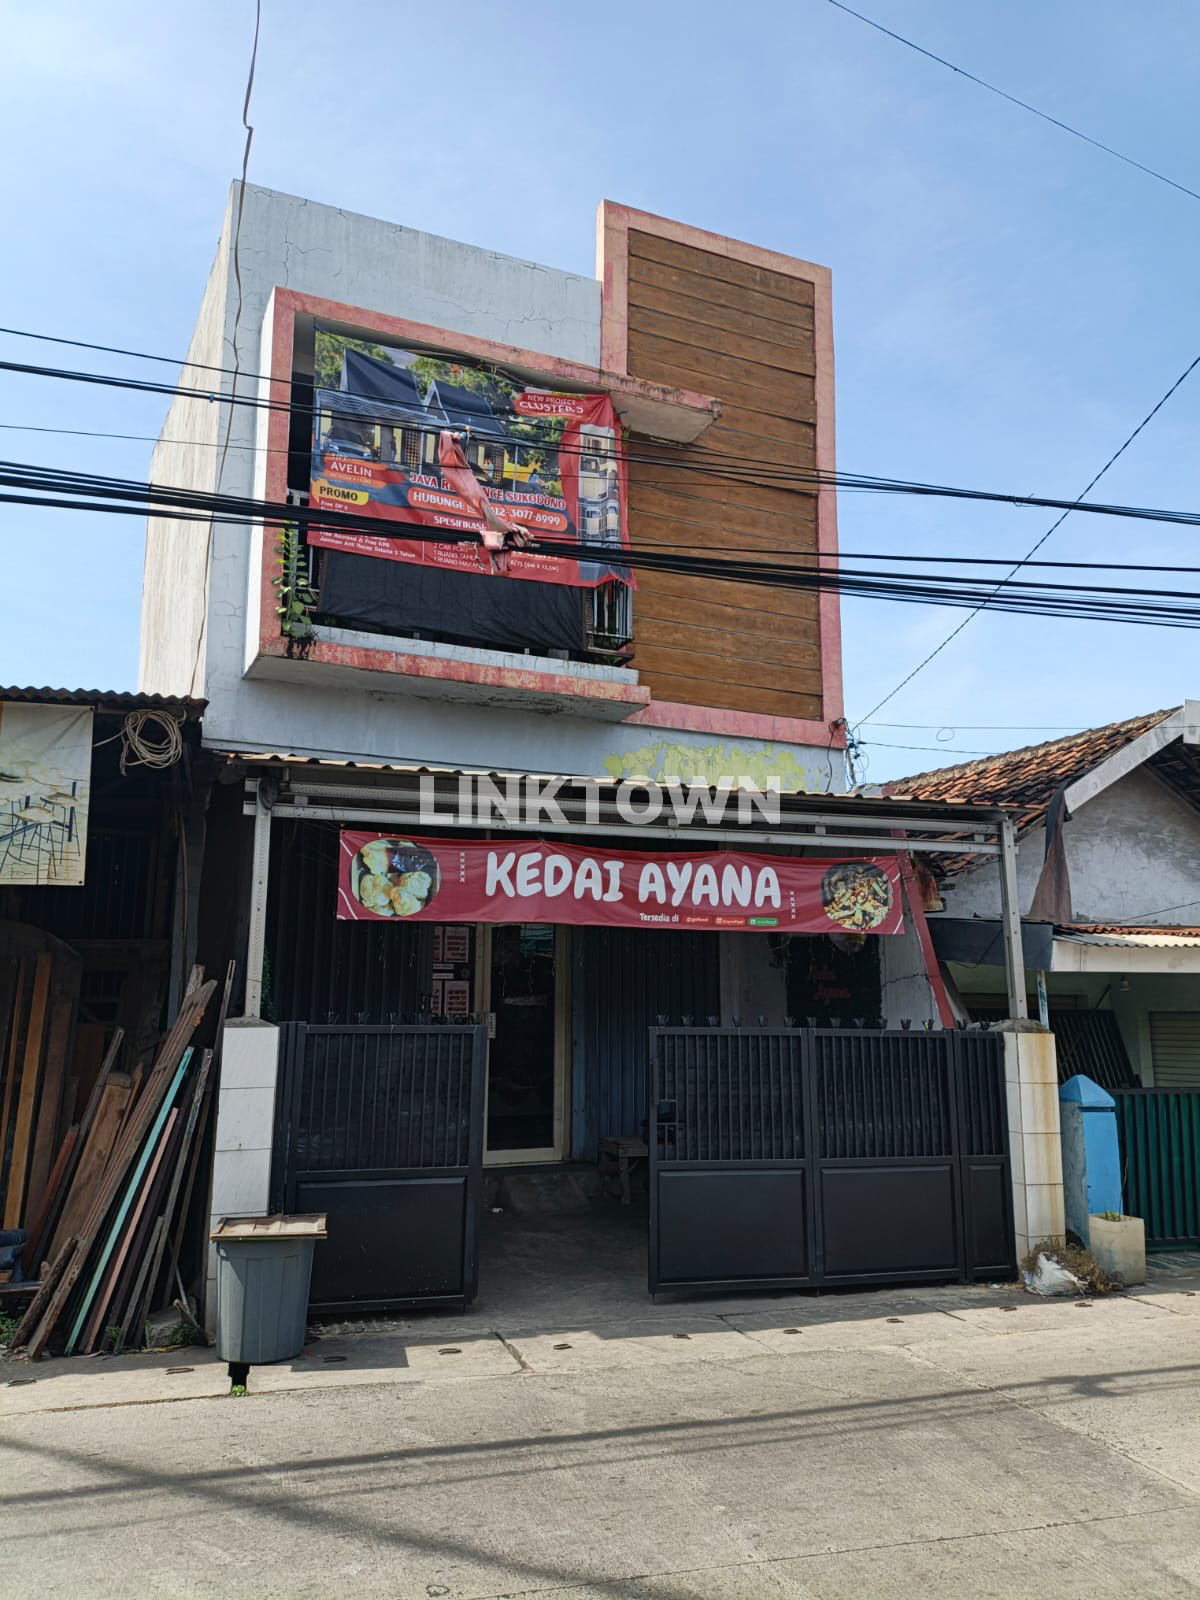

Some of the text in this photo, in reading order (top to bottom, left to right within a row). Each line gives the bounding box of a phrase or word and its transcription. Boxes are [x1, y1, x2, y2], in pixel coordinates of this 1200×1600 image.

[546, 397, 577, 406] PROJECT
[330, 461, 373, 478] AVELIN
[319, 486, 358, 502] PROMO
[409, 471, 567, 511] JAVA SUKODONO
[413, 491, 465, 511] HUBUNGI:
[433, 515, 487, 532] SPESIFIKASI:
[437, 551, 458, 559] RUANG
[438, 543, 452, 551] CAR
[485, 851, 783, 909] KEDAI AYANA
[639, 912, 679, 922] Tersedia di
